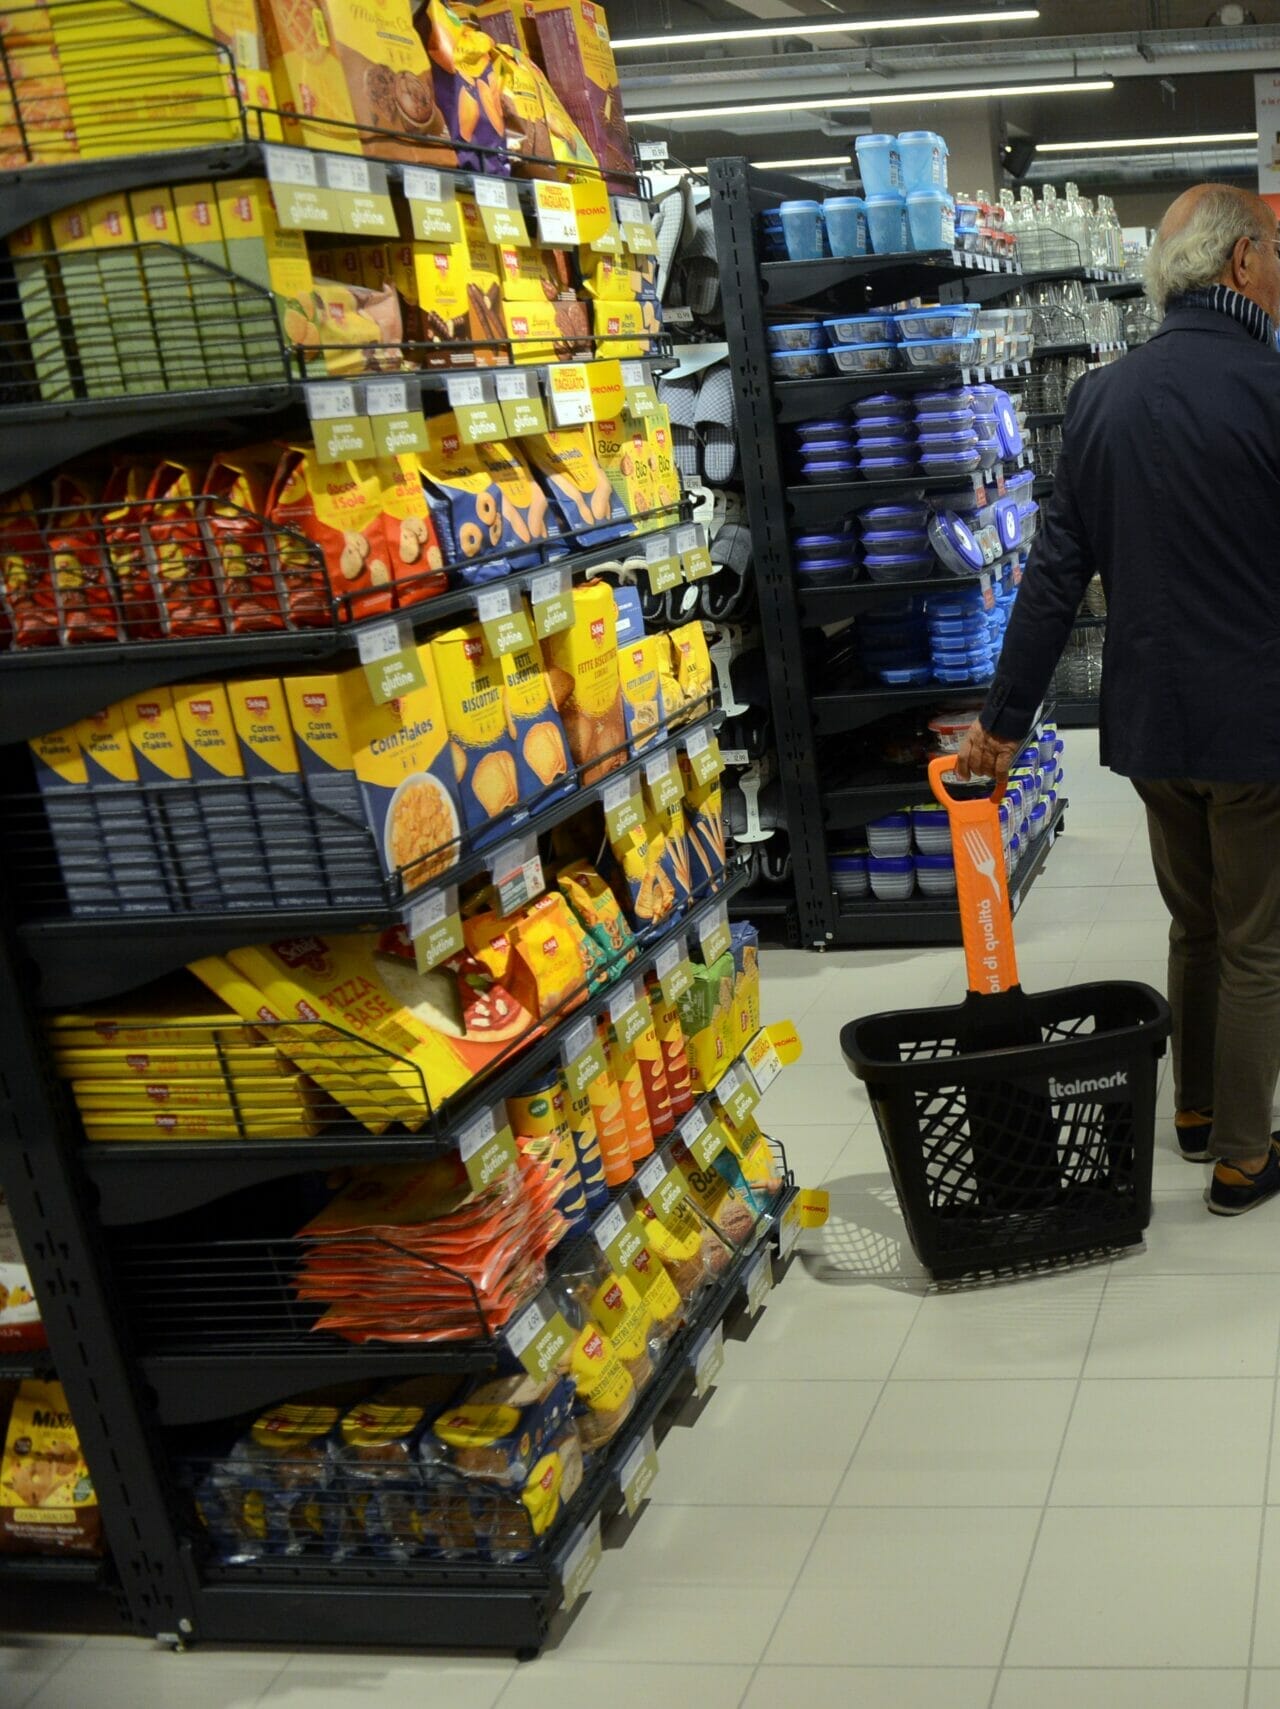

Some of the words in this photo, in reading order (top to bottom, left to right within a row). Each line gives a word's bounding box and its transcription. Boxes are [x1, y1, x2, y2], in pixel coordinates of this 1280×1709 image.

[289, 203, 329, 224] glutine
[351, 210, 385, 229] glutine
[576, 205, 607, 217] PROMO
[422, 216, 452, 236] glutine
[493, 221, 521, 240] glutine
[591, 385, 621, 394] PROMO
[634, 400, 655, 415] glutine
[469, 421, 497, 440] glutine
[514, 414, 538, 433] glutine
[327, 434, 364, 458] glutine
[385, 430, 418, 452] glutine
[689, 560, 706, 577] glutine
[656, 571, 676, 590] glutine
[543, 610, 568, 633] glutine
[497, 631, 523, 651] glutine
[381, 670, 415, 698] glutine
[471, 676, 491, 695] FETTE
[461, 688, 501, 714] BISCOTTATE
[142, 739, 173, 753] Flakes
[194, 737, 226, 750] Flakes
[249, 733, 282, 745] Flakes
[306, 730, 339, 743] Flakes
[369, 732, 400, 756] Corn
[398, 718, 433, 743] Flakes
[701, 760, 718, 780] glutine
[661, 786, 678, 806] glutine
[616, 813, 637, 836] glutine
[976, 898, 1000, 951] qualità
[426, 935, 455, 965] glutine
[982, 956, 999, 970] di
[320, 975, 378, 1013] PIZZA
[669, 976, 688, 1000] glutine
[344, 995, 394, 1030] BASE
[625, 1017, 646, 1043] glutine
[773, 1036, 797, 1048] PROMO
[577, 1062, 599, 1090] glutine
[1048, 1071, 1128, 1098] italmark
[531, 1103, 547, 1115] NEW
[737, 1097, 753, 1120] glutine
[703, 1138, 721, 1163] glutine
[480, 1151, 508, 1184] glutine
[661, 1186, 682, 1214] glutine
[619, 1236, 642, 1268] glutine
[538, 1335, 565, 1373] glutine
